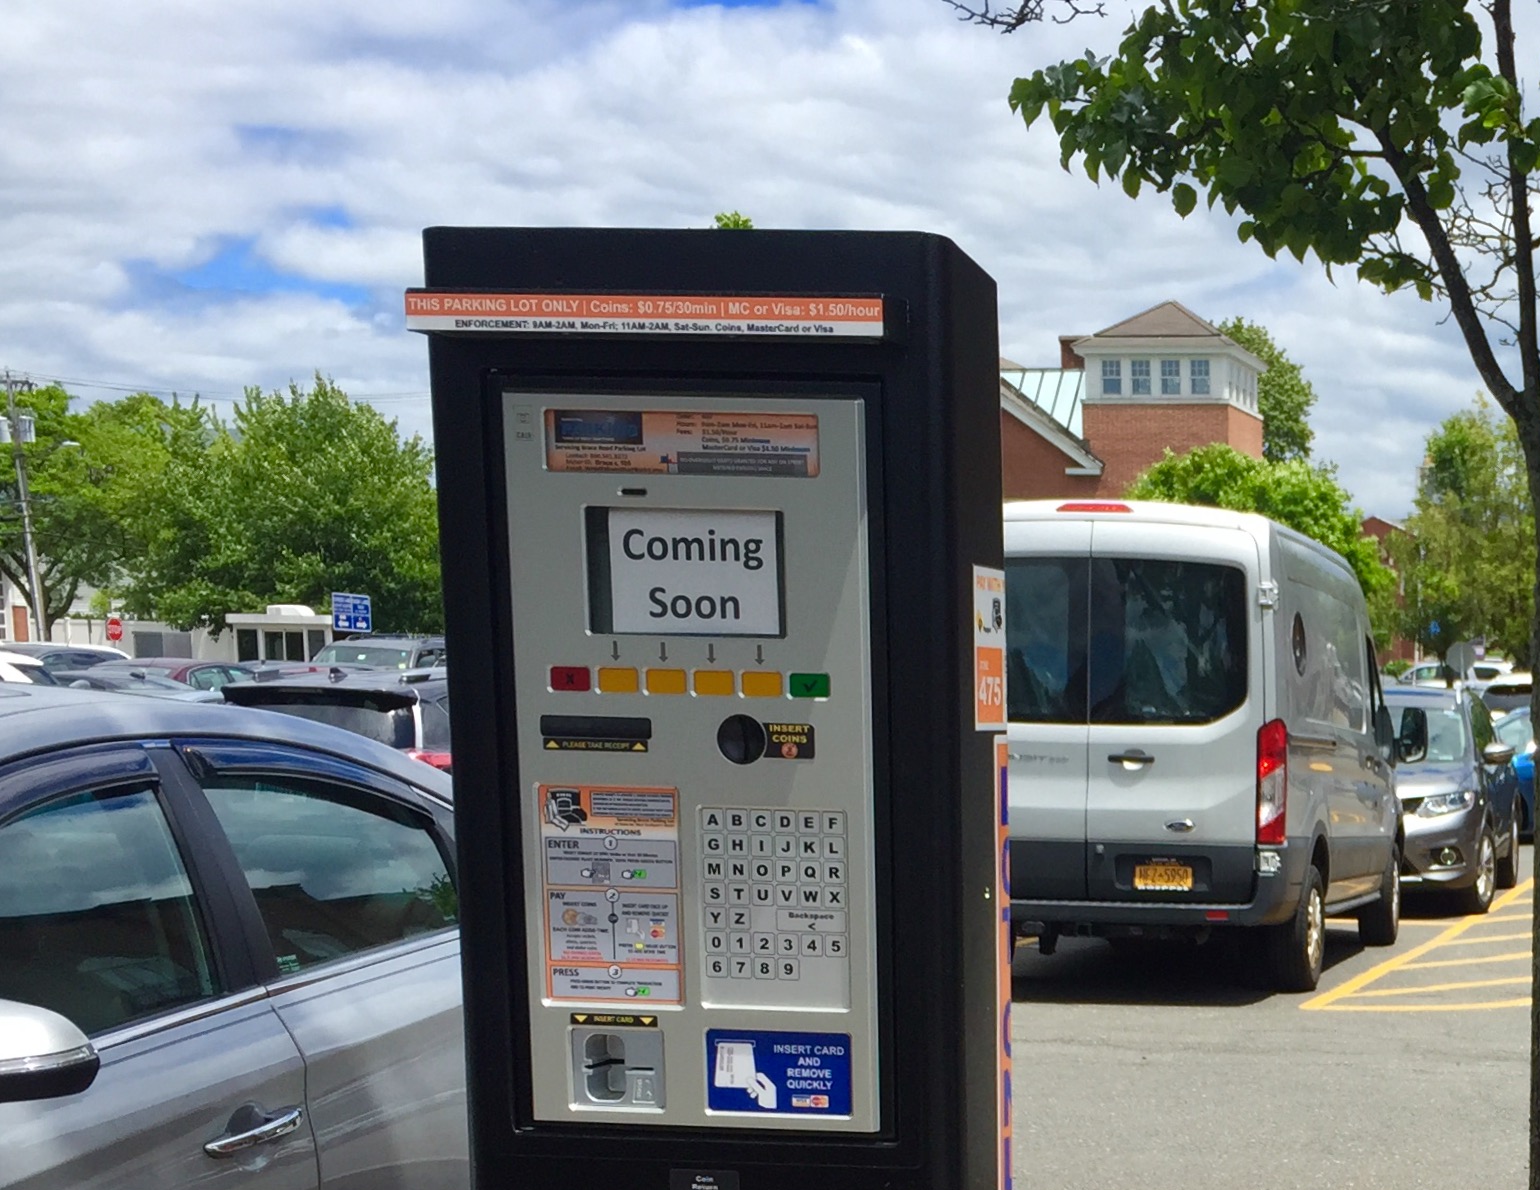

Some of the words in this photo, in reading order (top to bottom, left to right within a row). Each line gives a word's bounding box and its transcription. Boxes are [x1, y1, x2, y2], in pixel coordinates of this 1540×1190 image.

[409, 298, 439, 310] THIS
[444, 298, 507, 311] PARKING
[511, 300, 538, 312] LOT
[542, 300, 579, 312] ONLY
[590, 301, 632, 313] Coins:
[638, 302, 716, 314] $0.75/30min
[729, 303, 749, 314] MC
[754, 305, 768, 314] or
[773, 304, 804, 315] Visa:
[809, 304, 879, 316] $1.50/hour
[455, 320, 529, 328] ENFORCEMENT:
[532, 321, 578, 330] 9AM-2AM,
[581, 321, 618, 331] Mon-Fri;
[621, 322, 671, 331] 11AM-2AM,
[674, 322, 713, 331] Sat-Sun.
[715, 323, 744, 333] Coins,
[747, 324, 799, 332] MasterCard
[813, 324, 833, 333] Visa
[623, 529, 763, 570] Coming
[649, 587, 740, 619] Soon
[979, 677, 1001, 705] 475
[769, 724, 810, 733] INSERT
[772, 734, 808, 743] COINS
[707, 814, 718, 825] A
[732, 815, 742, 826] B
[756, 815, 766, 827] C
[780, 816, 790, 827] D
[804, 817, 813, 828] E
[829, 818, 837, 829] F
[548, 840, 579, 849] ENTER
[708, 838, 719, 850] G
[732, 839, 743, 851] H
[782, 841, 790, 852] J
[804, 842, 815, 853] K
[829, 842, 838, 854] L
[708, 863, 720, 875] M
[733, 864, 744, 875] N
[757, 865, 768, 876] O
[782, 865, 791, 877] P
[804, 866, 816, 878] Q
[829, 867, 840, 878] R
[710, 888, 720, 899] S
[734, 888, 744, 900] T
[758, 889, 768, 901] U
[781, 890, 792, 901] V
[803, 891, 818, 902] W
[830, 892, 840, 903] X
[711, 912, 721, 923] Y
[735, 913, 745, 924] Z
[788, 912, 834, 920] Backspace
[712, 937, 721, 948] 0
[760, 938, 769, 949] 2
[784, 939, 793, 950] 3
[807, 940, 817, 951] 4
[832, 941, 840, 952] 5
[774, 1045, 812, 1055] INSERT
[814, 1045, 844, 1056] CARD
[798, 1057, 820, 1067] AND
[787, 1068, 832, 1079] REMOVE
[786, 1079, 833, 1090] QUICKLY
